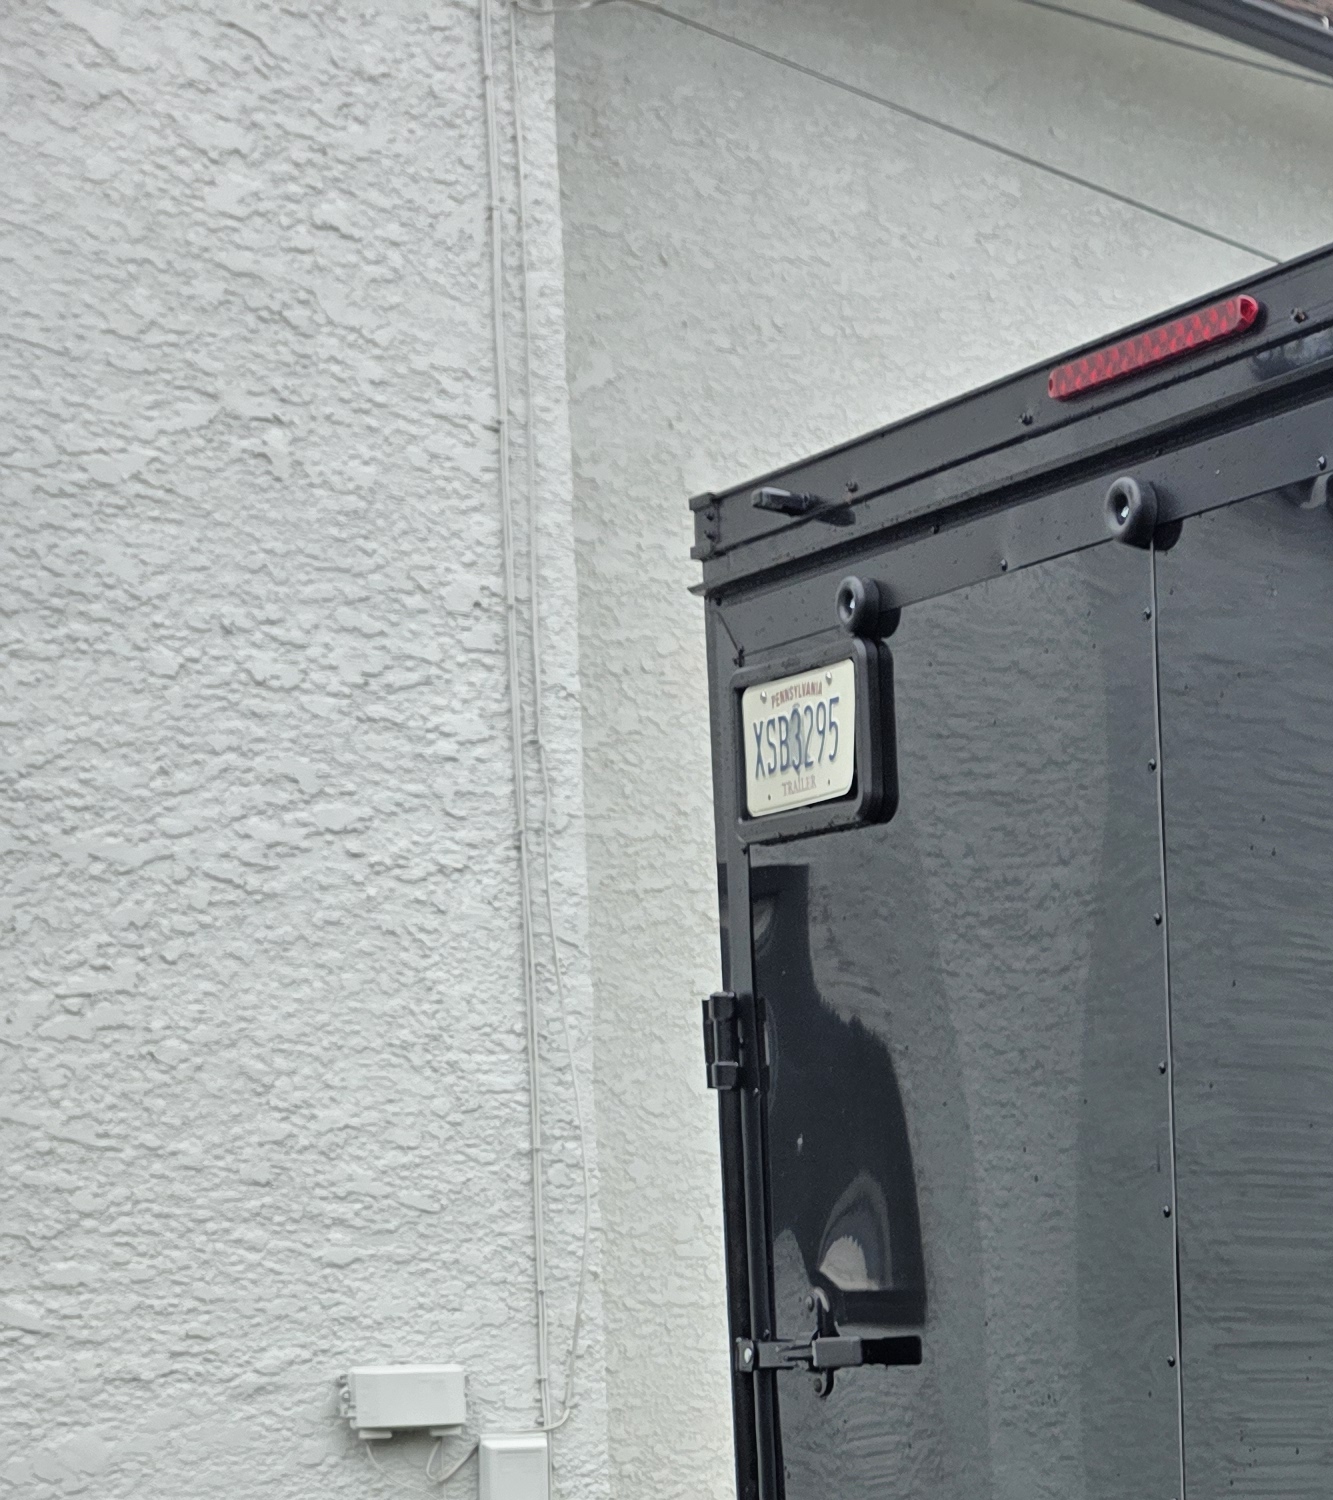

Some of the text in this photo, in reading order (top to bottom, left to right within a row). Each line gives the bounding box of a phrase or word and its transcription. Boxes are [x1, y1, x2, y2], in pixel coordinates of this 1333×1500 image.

[770, 681, 823, 709] PENNSYLVANIA
[752, 696, 840, 780] XSB3295
[781, 775, 818, 797] TRAILER
